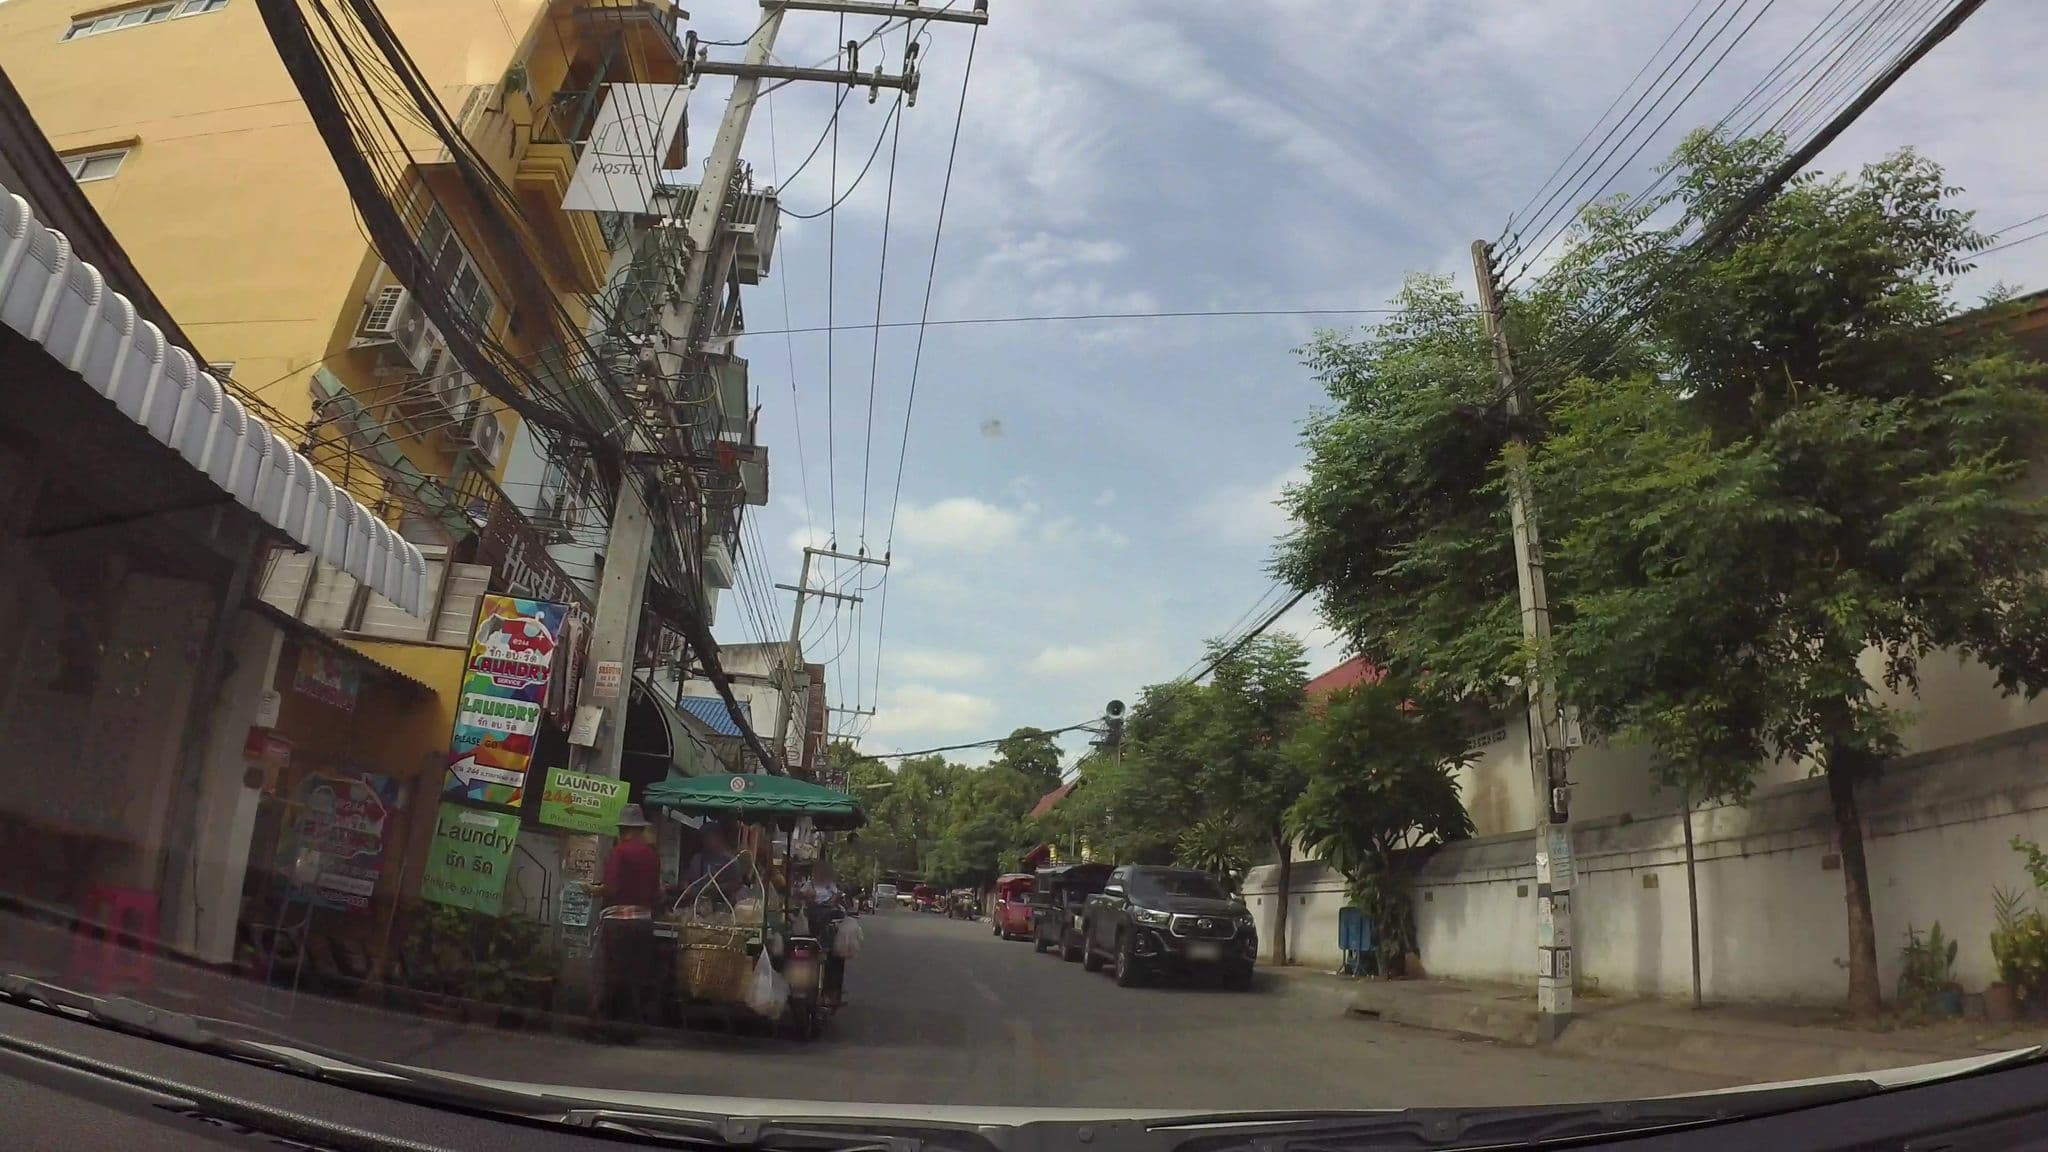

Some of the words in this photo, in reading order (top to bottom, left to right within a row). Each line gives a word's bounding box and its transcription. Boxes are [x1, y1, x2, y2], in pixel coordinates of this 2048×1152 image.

[592, 162, 644, 176] HOSTEL
[468, 656, 550, 681] LAUNDRY
[462, 697, 540, 722] LAUNDRY
[454, 734, 481, 746] PLEASE
[484, 739, 498, 749] GO
[556, 774, 618, 796] LAUNDRY
[437, 818, 514, 855] Laundry
